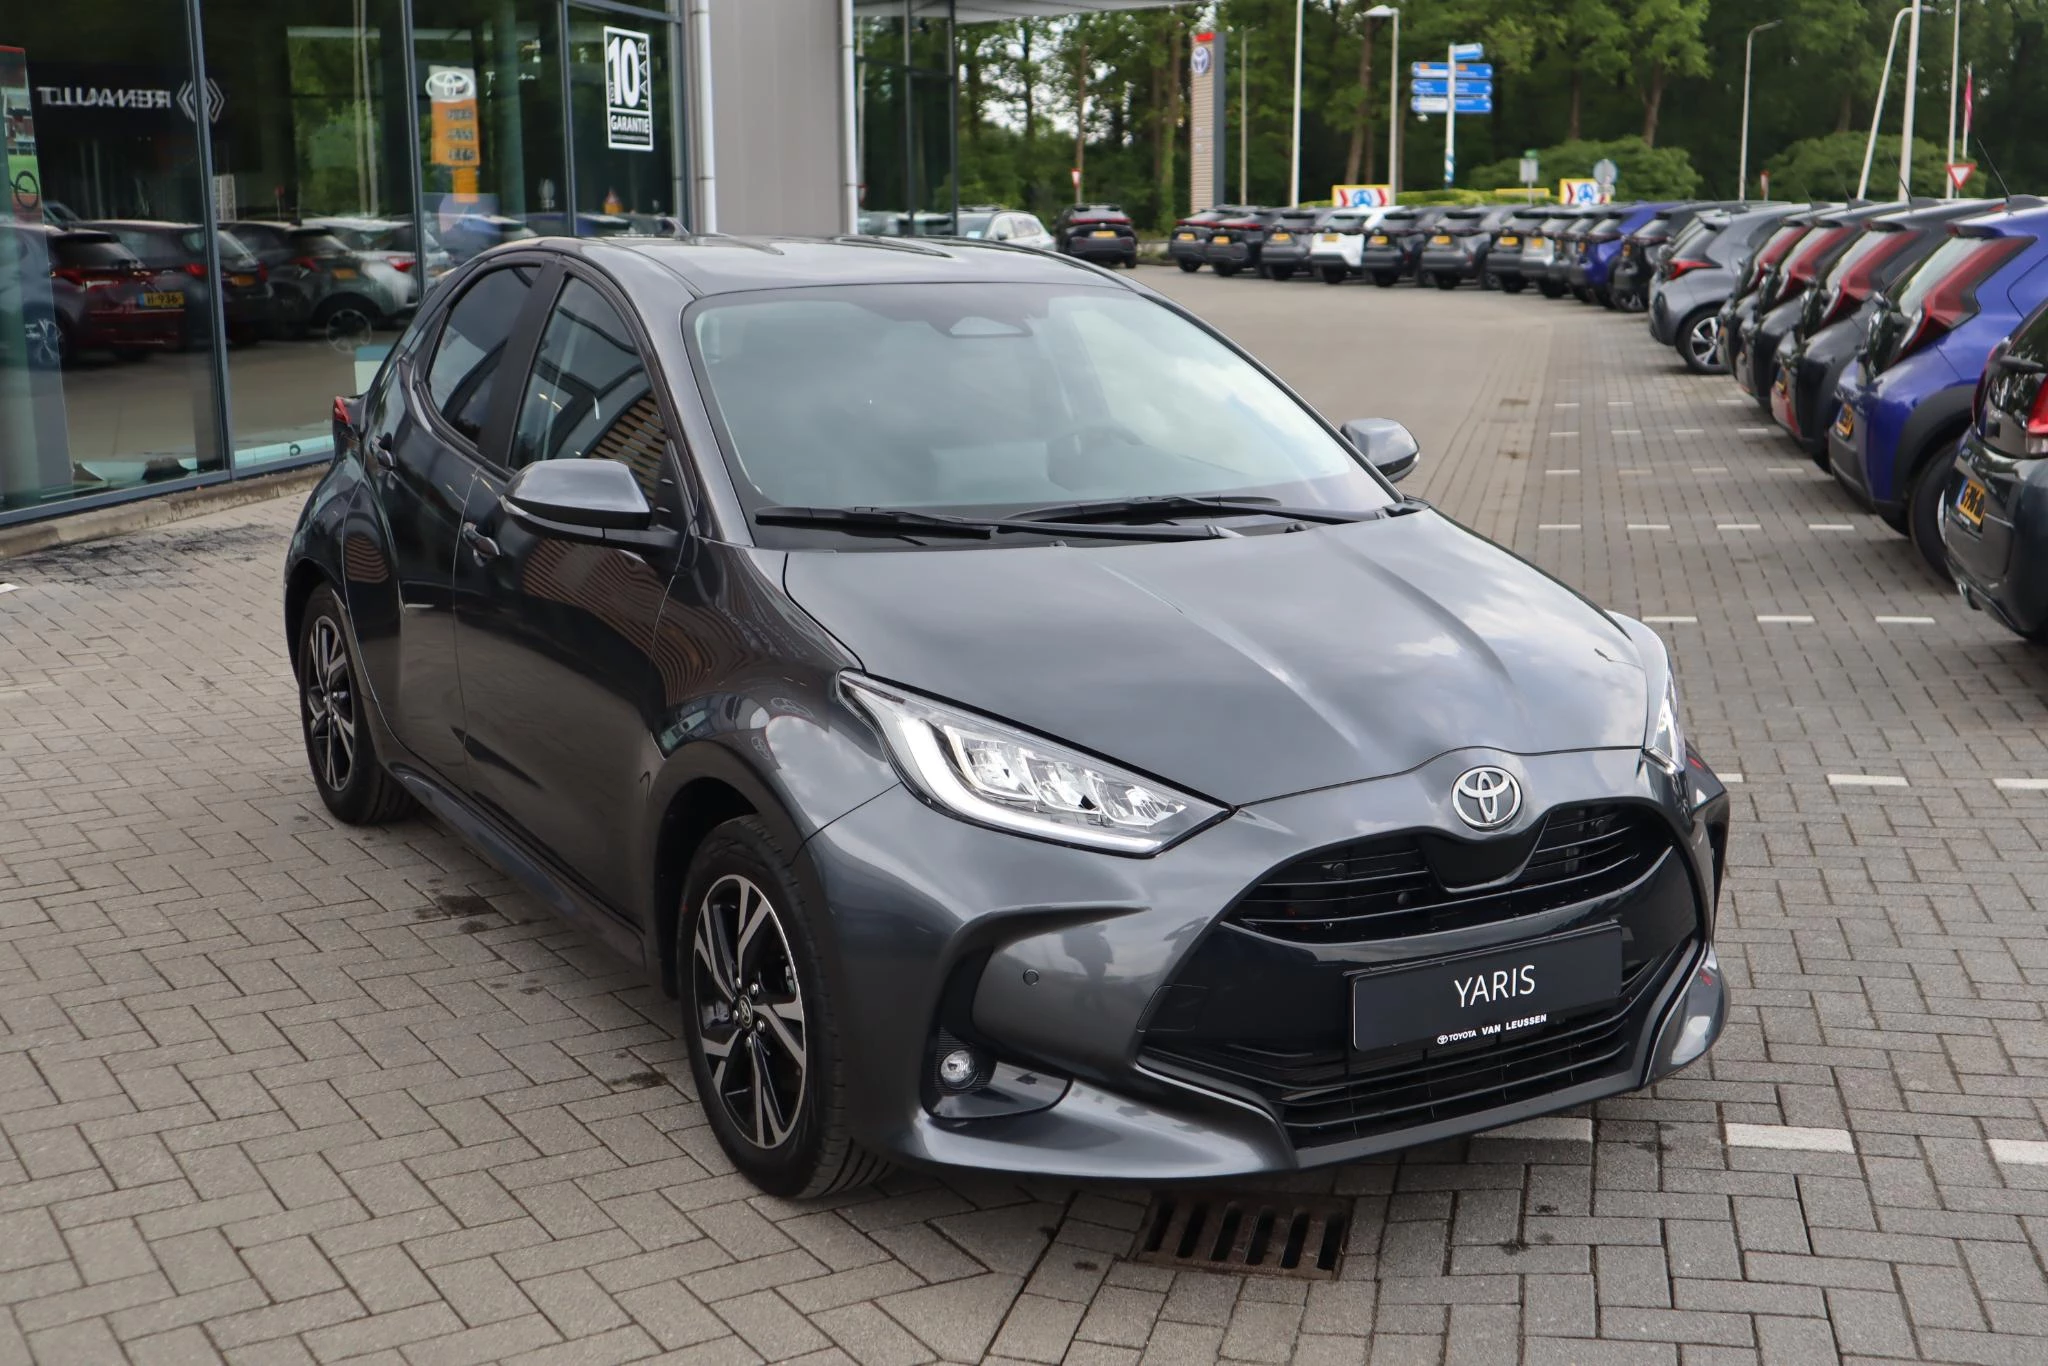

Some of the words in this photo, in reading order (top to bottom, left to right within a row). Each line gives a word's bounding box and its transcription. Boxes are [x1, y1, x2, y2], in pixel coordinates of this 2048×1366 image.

[608, 36, 640, 107] 10
[638, 42, 648, 108] JAAR
[611, 115, 649, 133] GARANTIE
[1454, 965, 1535, 1008] YARIS
[1449, 1030, 1476, 1041] TOYOTA
[1482, 1024, 1501, 1035] VAN
[1506, 1014, 1547, 1030] LEUSSEN
